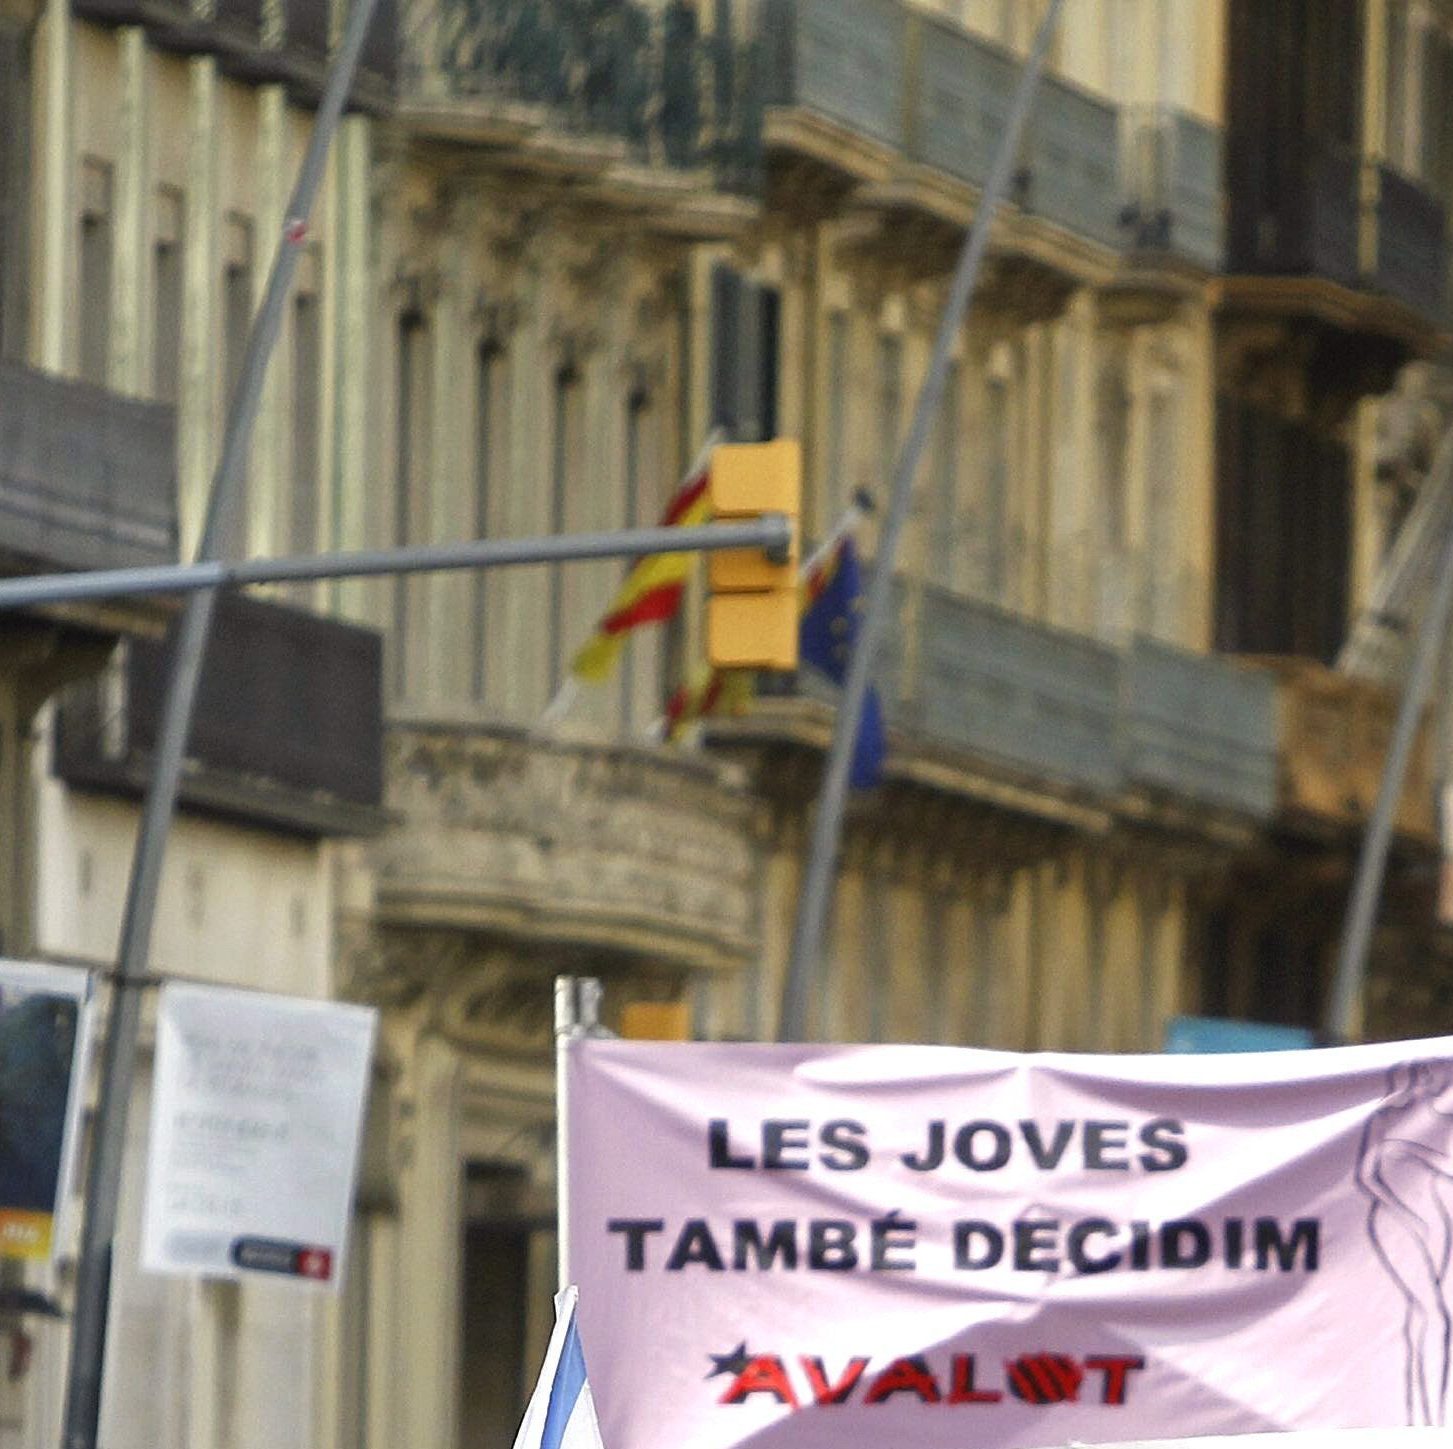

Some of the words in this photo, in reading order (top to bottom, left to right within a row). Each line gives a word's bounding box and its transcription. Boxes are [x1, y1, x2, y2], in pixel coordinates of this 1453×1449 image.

[706, 1117, 871, 1173] LES
[900, 1117, 1190, 1173] JOVES
[607, 1210, 918, 1274] TAMBÉ
[951, 1217, 1321, 1275] DECIDIM
[717, 1351, 1147, 1412] AVALOT
